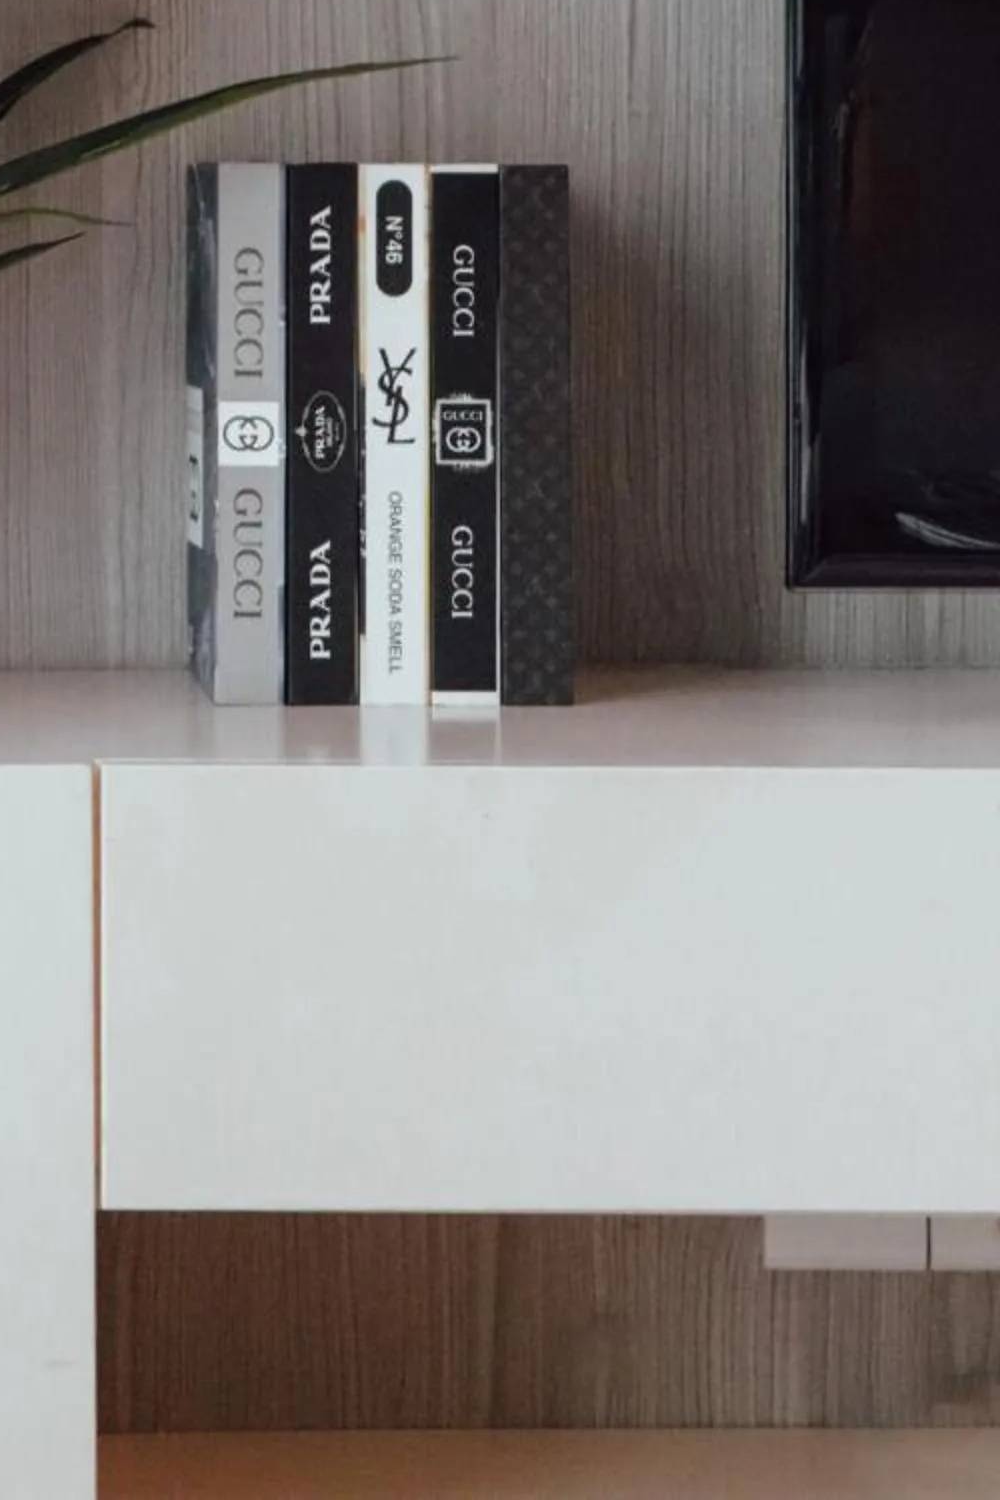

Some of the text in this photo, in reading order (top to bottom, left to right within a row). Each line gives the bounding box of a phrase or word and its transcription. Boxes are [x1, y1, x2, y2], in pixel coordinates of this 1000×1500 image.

[233, 246, 265, 379] GUCCI
[309, 205, 332, 325] PRADA
[452, 244, 475, 338] GUCCI
[314, 406, 325, 459] PRADA
[233, 487, 264, 619] GUCCI
[309, 539, 332, 660] PRADA
[388, 491, 403, 674] ORANGE SODA SMELL
[451, 525, 474, 619] GUCCI
